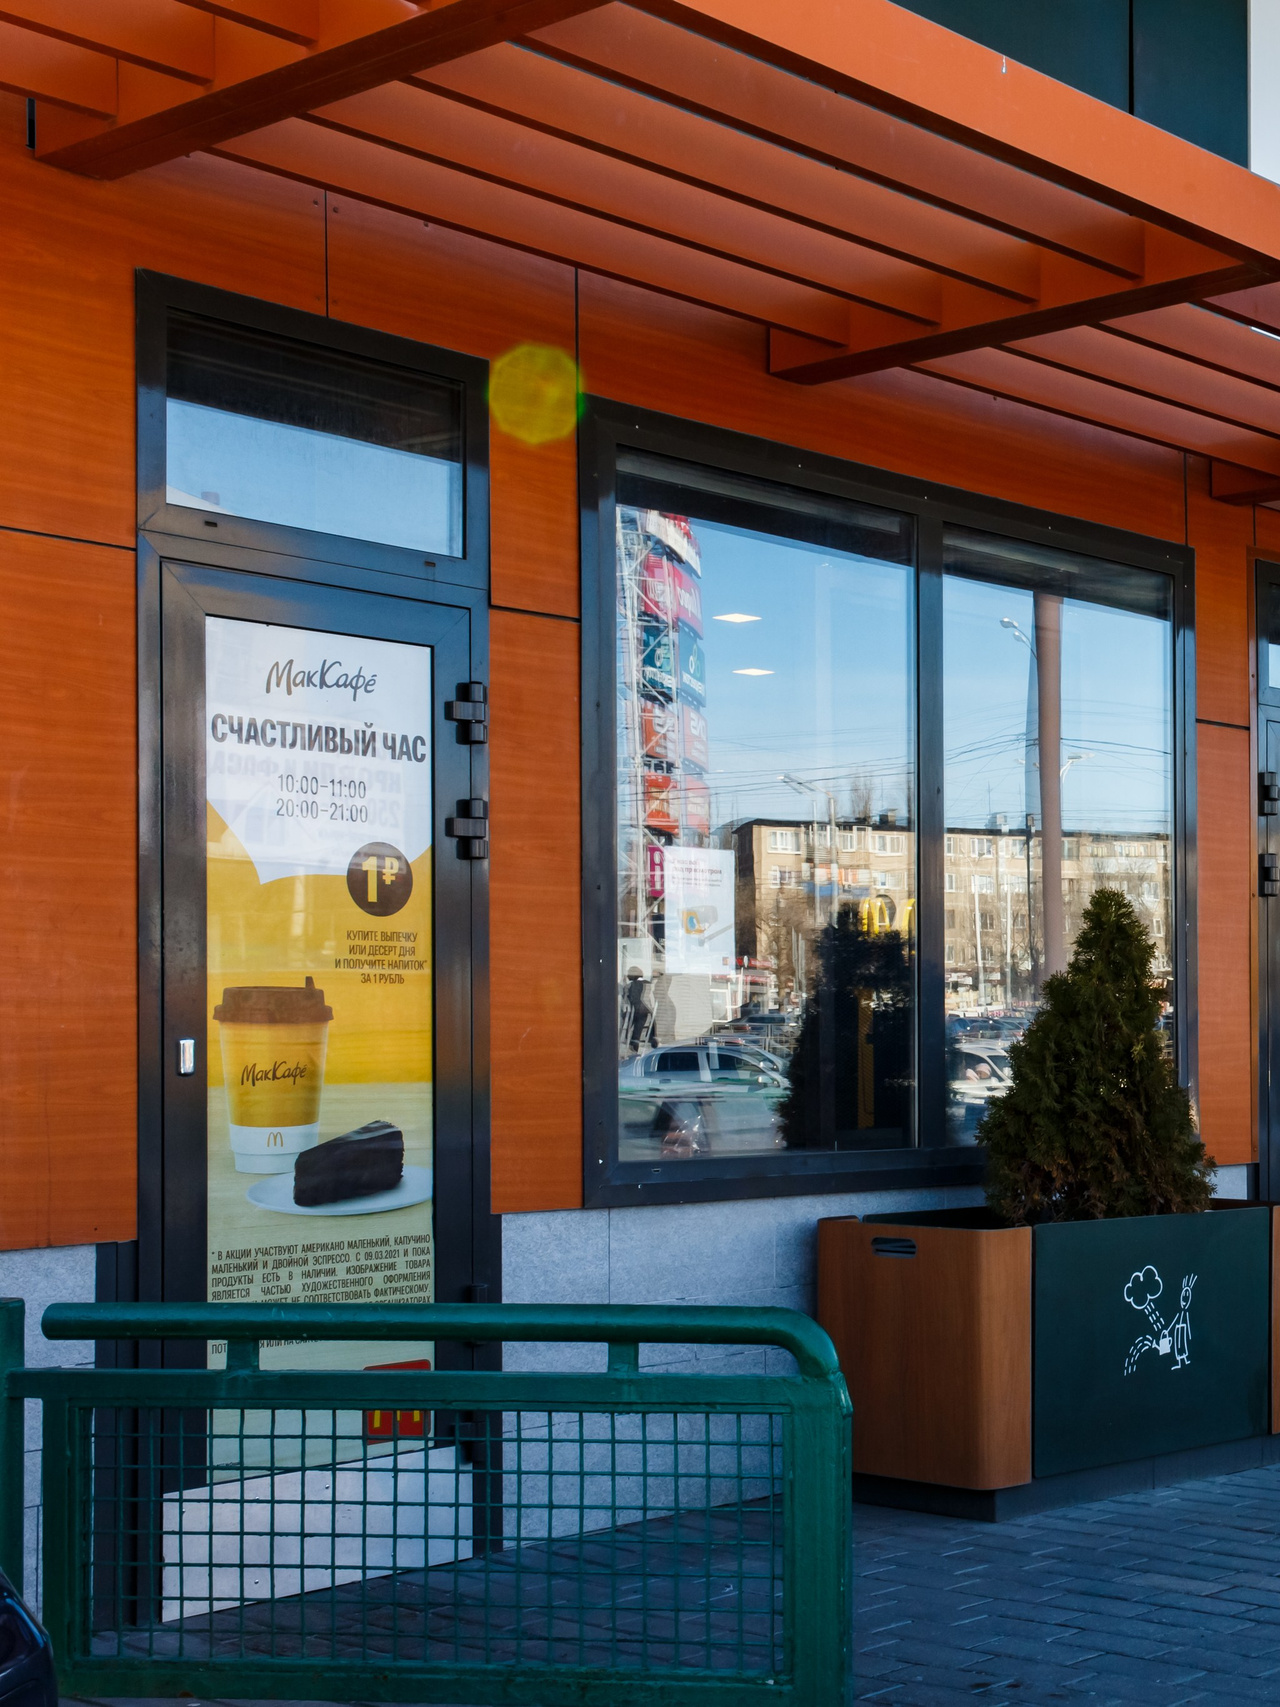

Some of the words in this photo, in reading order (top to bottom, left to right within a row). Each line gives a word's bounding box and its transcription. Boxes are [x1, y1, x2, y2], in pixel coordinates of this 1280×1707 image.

[211, 712, 377, 758] СЧАСТЛИВЫЙ
[382, 732, 427, 763] ЧАС
[346, 930, 378, 942] КУПИТЕ
[380, 931, 418, 943] ВЫПЕЧКУ
[348, 944, 367, 956] ИЛИ
[367, 944, 398, 957] ДЕСЕРТ
[398, 945, 416, 958] ДНЯ
[334, 958, 341, 969] И
[343, 958, 386, 970] ПОЛУЧИТЕ
[360, 973, 372, 984] ЗА
[373, 973, 377, 984] 1
[378, 973, 405, 985] РУБЛЬ
[217, 1250, 223, 1260] В
[225, 1247, 252, 1260] АКЦИИ
[254, 1244, 299, 1257] УЧАСТВУЮТ
[301, 1240, 345, 1253] АМЕРИКАНО
[347, 1234, 392, 1249] МАЛЕНЬКИЙ,
[394, 1233, 431, 1246] КАПУЧИНО
[211, 1259, 259, 1274] МАЛЕНЬКИЙ
[262, 1260, 268, 1270] И
[271, 1254, 309, 1270] ДВОЙНОЙ
[312, 1252, 352, 1266] ЭСПРЕССО.
[355, 1251, 361, 1261] С
[364, 1249, 400, 1261] 09.03.2021
[403, 1248, 409, 1257] И
[412, 1246, 431, 1257] ПОКА
[211, 1274, 254, 1288] ПРОДУКТЫ
[262, 1271, 281, 1283] ЕСТЬ
[288, 1270, 294, 1281] В
[301, 1267, 338, 1279] НАЛИЧИИ.
[345, 1261, 398, 1275] ИЗОБРАЖЕНИЕ
[405, 1258, 431, 1269] ТОВАРА
[211, 1287, 251, 1301] ЯВЛЯЕТСЯ
[261, 1284, 292, 1296] ЧАСТЬЮ
[301, 1276, 374, 1293] ХУДОЖЕСТВЕННОГО
[383, 1270, 431, 1284] ОФОРМЛЕНИЯ
[373, 1283, 431, 1298] ФАКТИЧЕСКОМУ.
